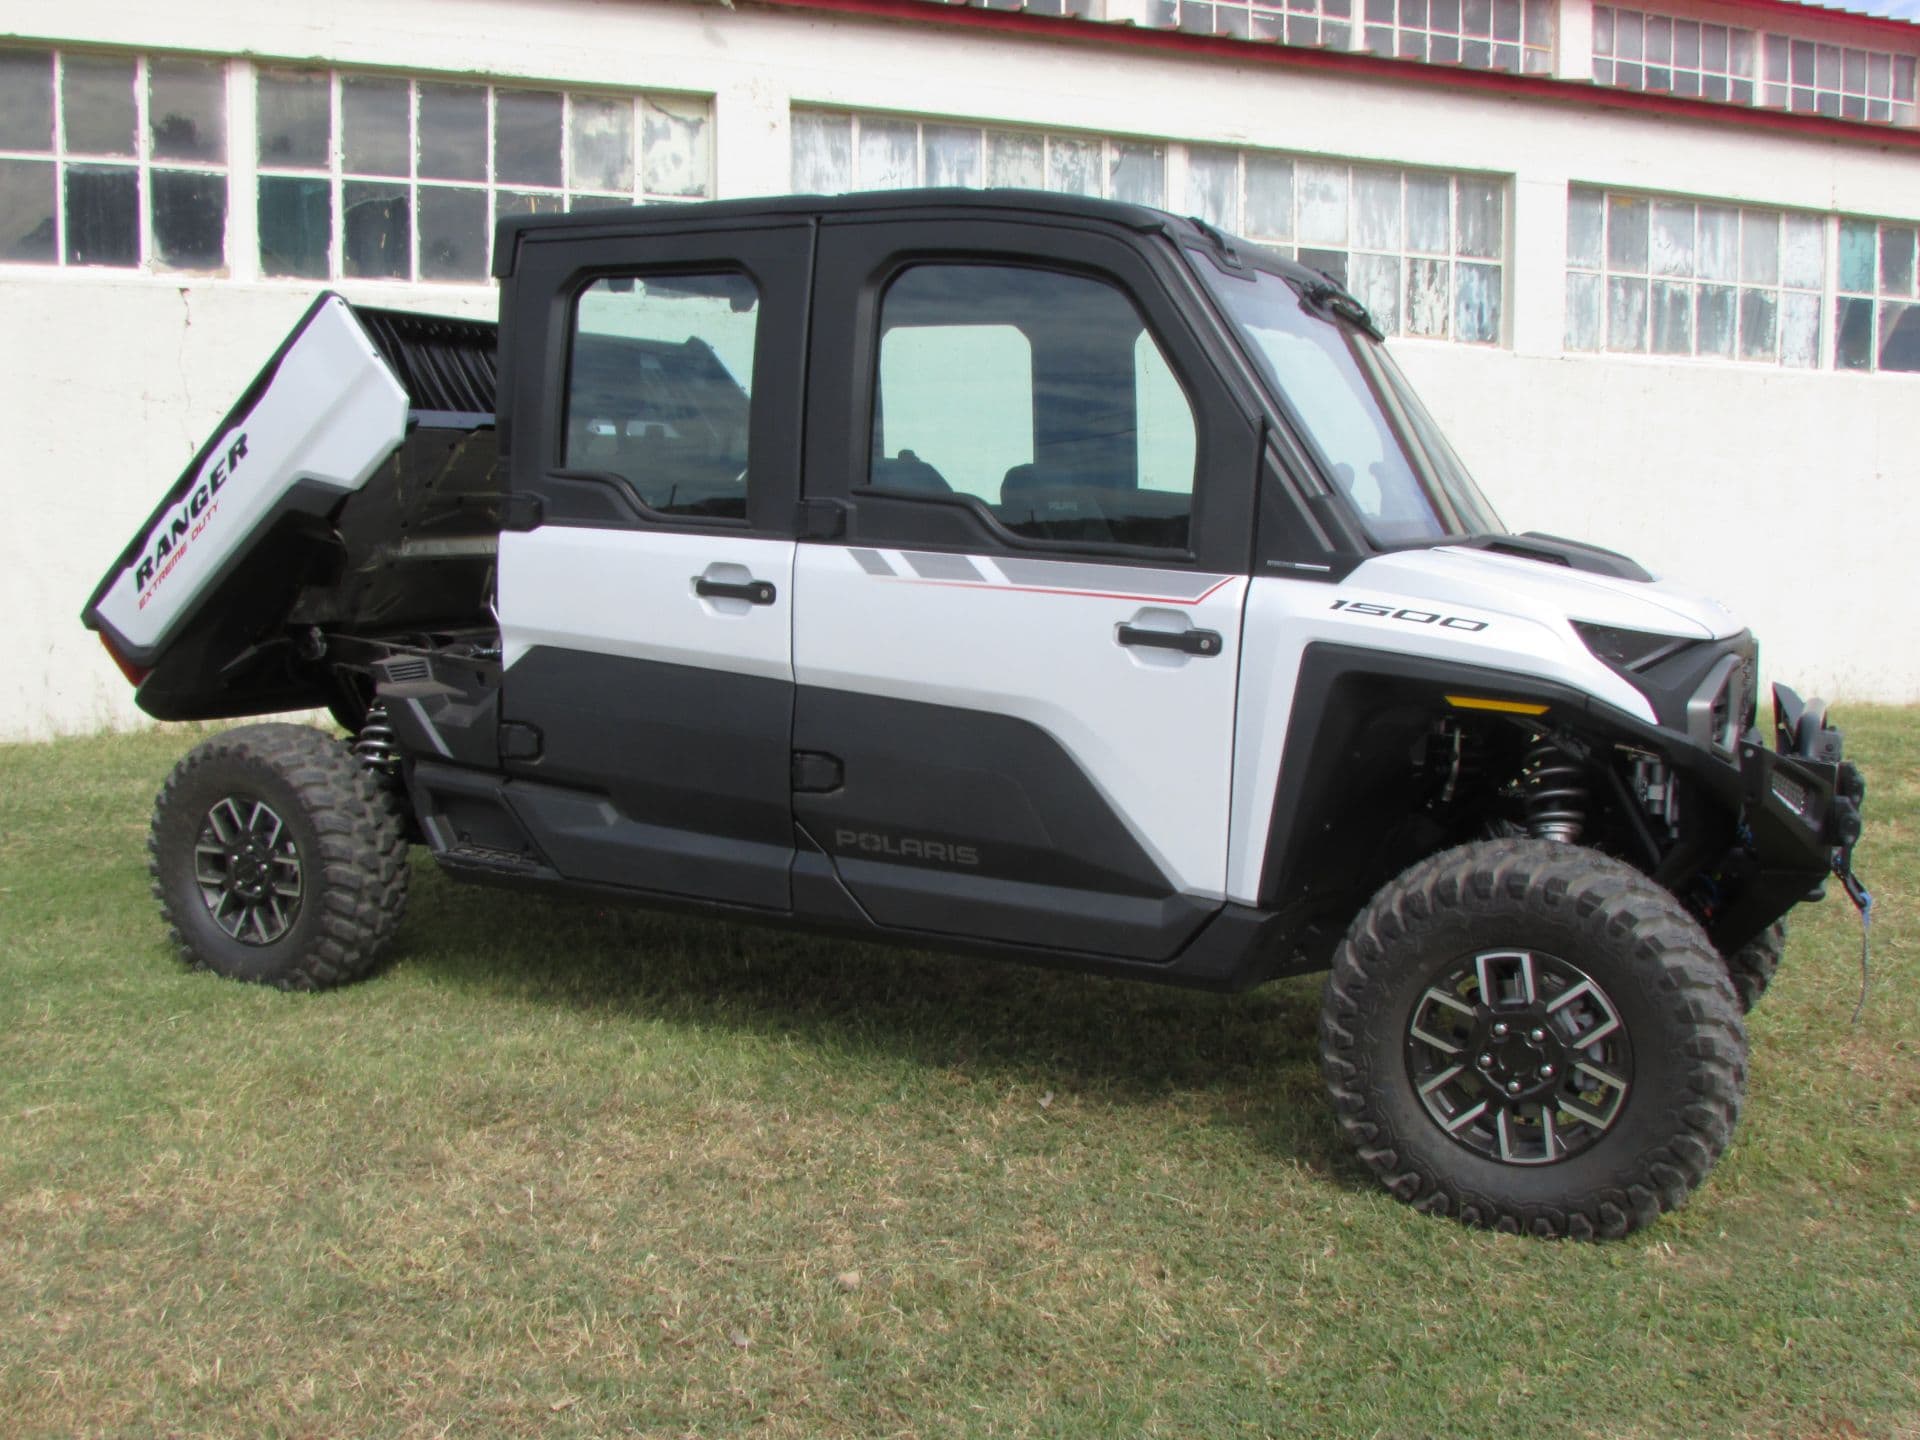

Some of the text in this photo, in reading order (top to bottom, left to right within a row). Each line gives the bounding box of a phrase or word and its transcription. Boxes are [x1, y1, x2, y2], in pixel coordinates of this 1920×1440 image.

[136, 433, 249, 593] RANGER
[139, 499, 219, 610] EXTREME DUTY
[1329, 599, 1489, 631] 1500
[835, 829, 979, 865] POLARIS
